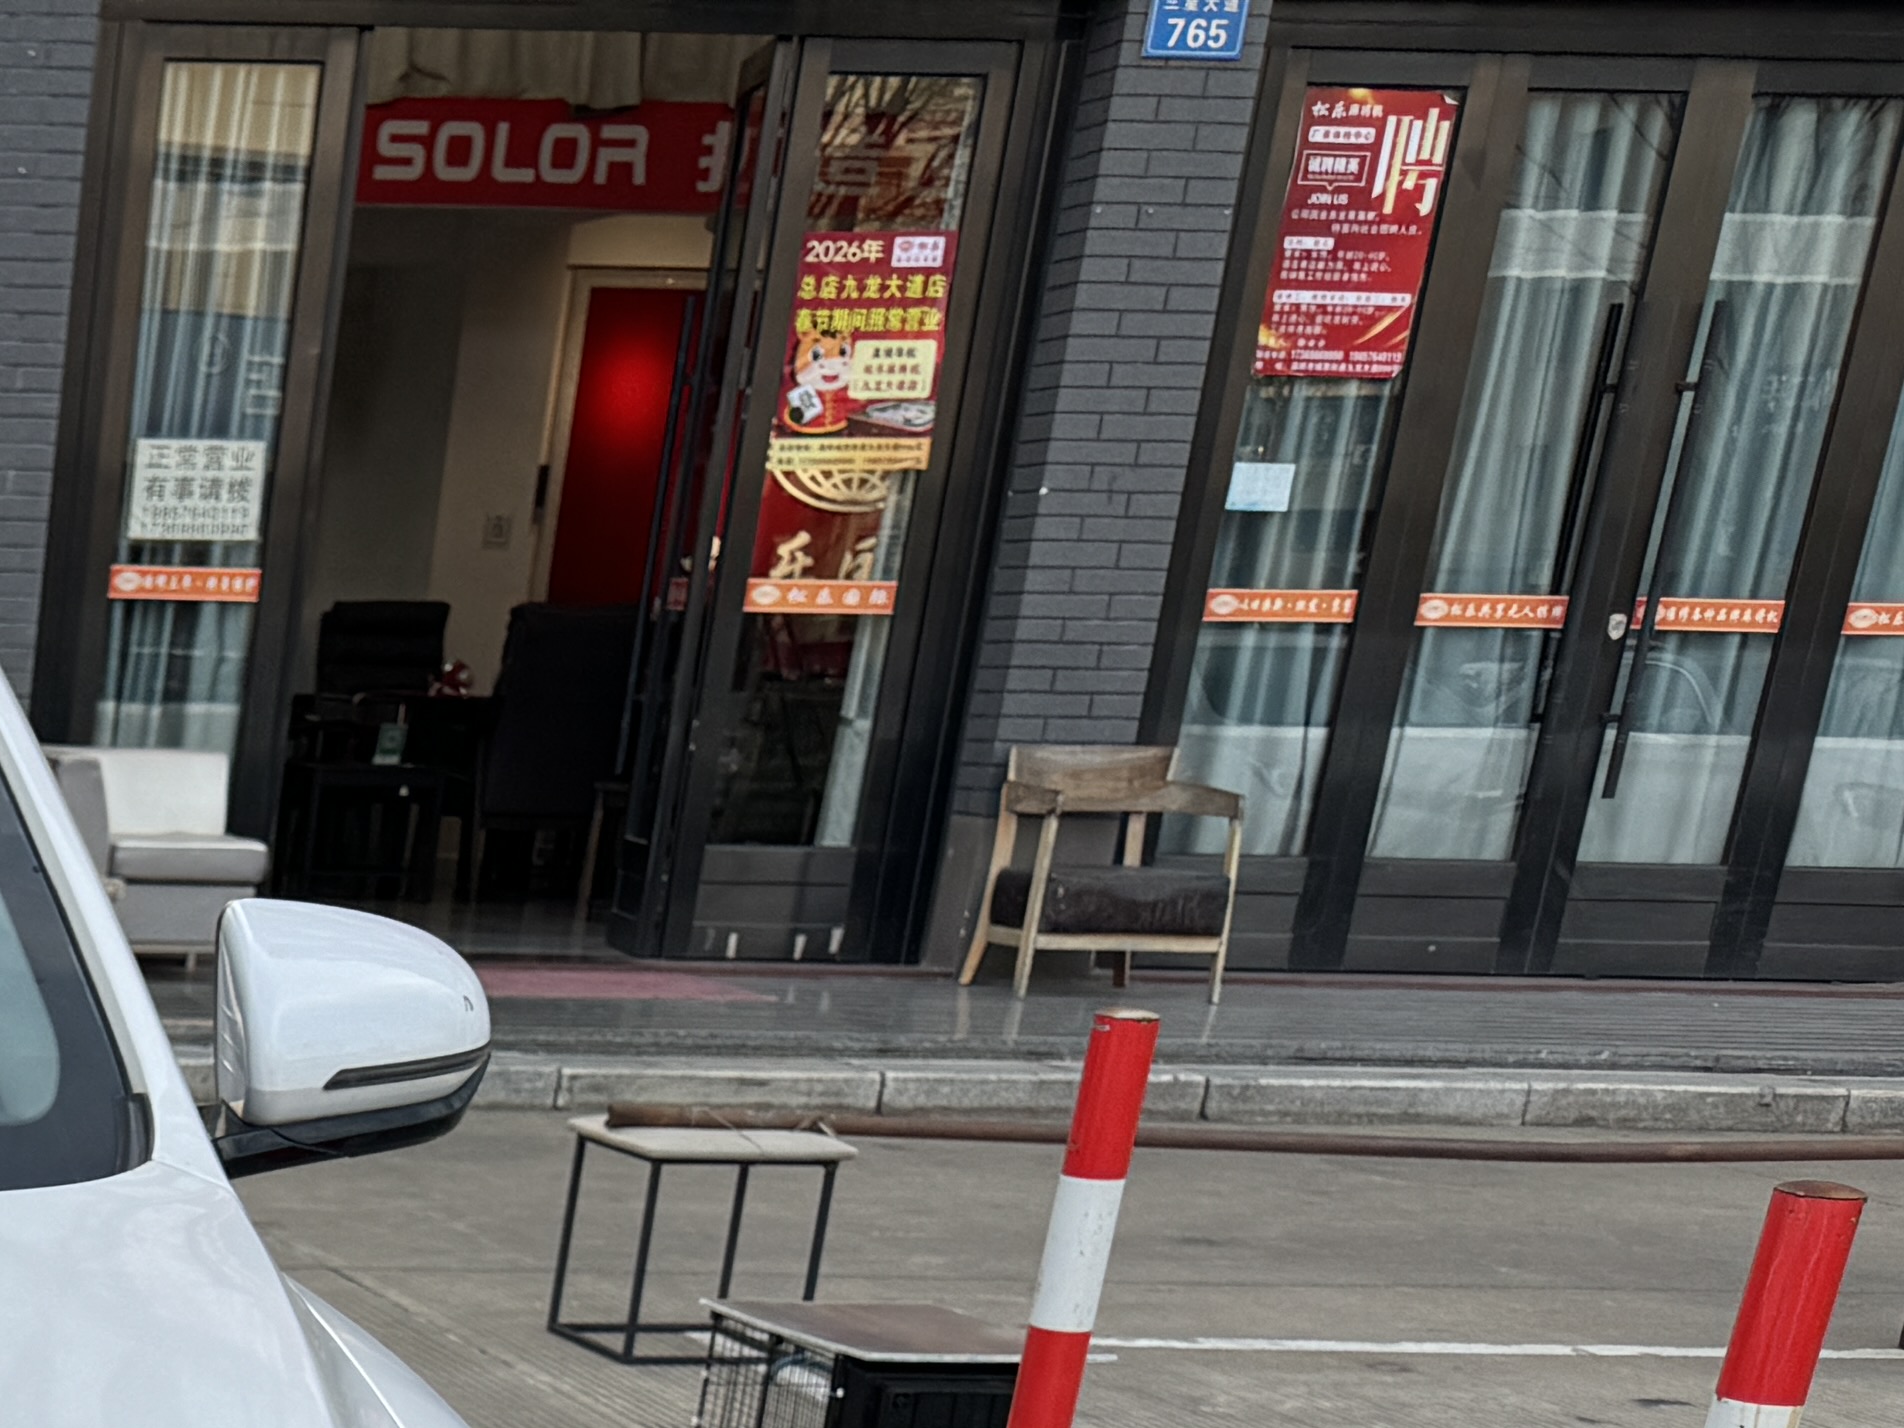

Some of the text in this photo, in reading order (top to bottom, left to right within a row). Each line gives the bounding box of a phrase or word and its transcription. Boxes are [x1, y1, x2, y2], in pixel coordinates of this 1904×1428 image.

[1166, 17, 1230, 49] 765
[371, 119, 650, 186] SOLOR
[1371, 107, 1451, 217] 聘
[804, 239, 886, 264] 2026年
[143, 443, 256, 472] 正常营业
